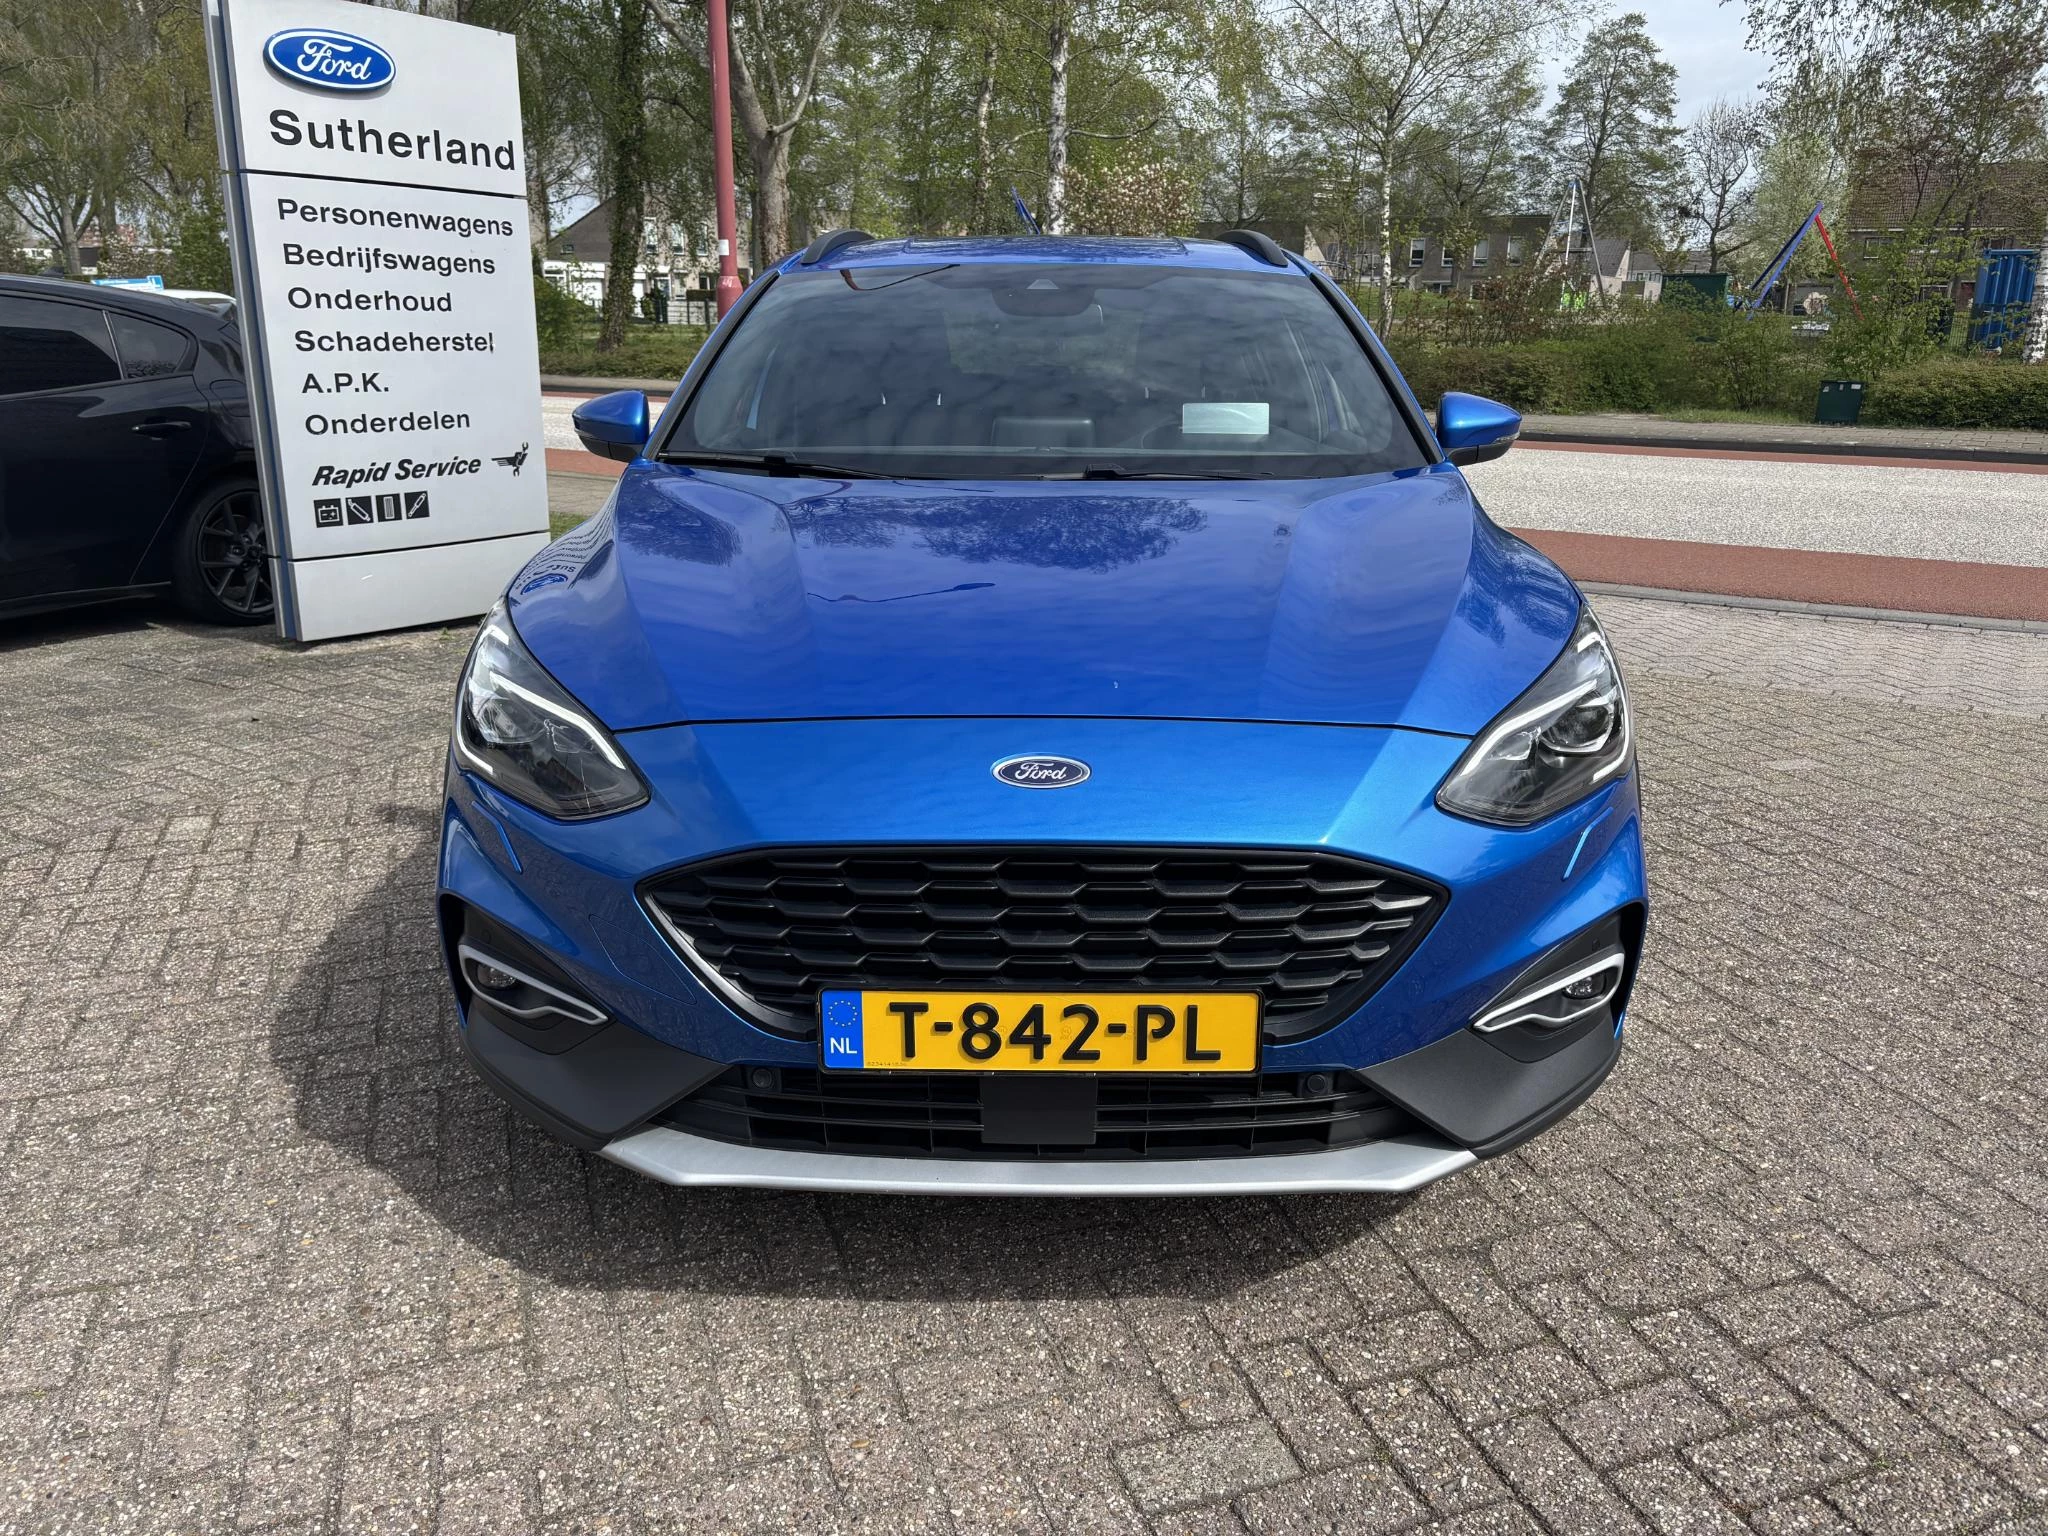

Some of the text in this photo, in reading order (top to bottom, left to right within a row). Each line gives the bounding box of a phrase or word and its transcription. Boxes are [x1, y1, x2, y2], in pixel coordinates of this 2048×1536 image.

[296, 38, 372, 81] Ford
[269, 109, 515, 171] Sutherland
[277, 198, 514, 238] Personenwagens
[283, 243, 496, 277] Bedrijfswagens
[287, 286, 452, 312] Onderhoud
[294, 330, 494, 353] Schadeherstel
[302, 372, 389, 393] A.P.K.
[305, 411, 470, 435] Onderdelen
[312, 456, 481, 488] Rapid Service
[1015, 762, 1067, 780] Ford
[830, 1001, 1221, 1061] NL T-842-PL
